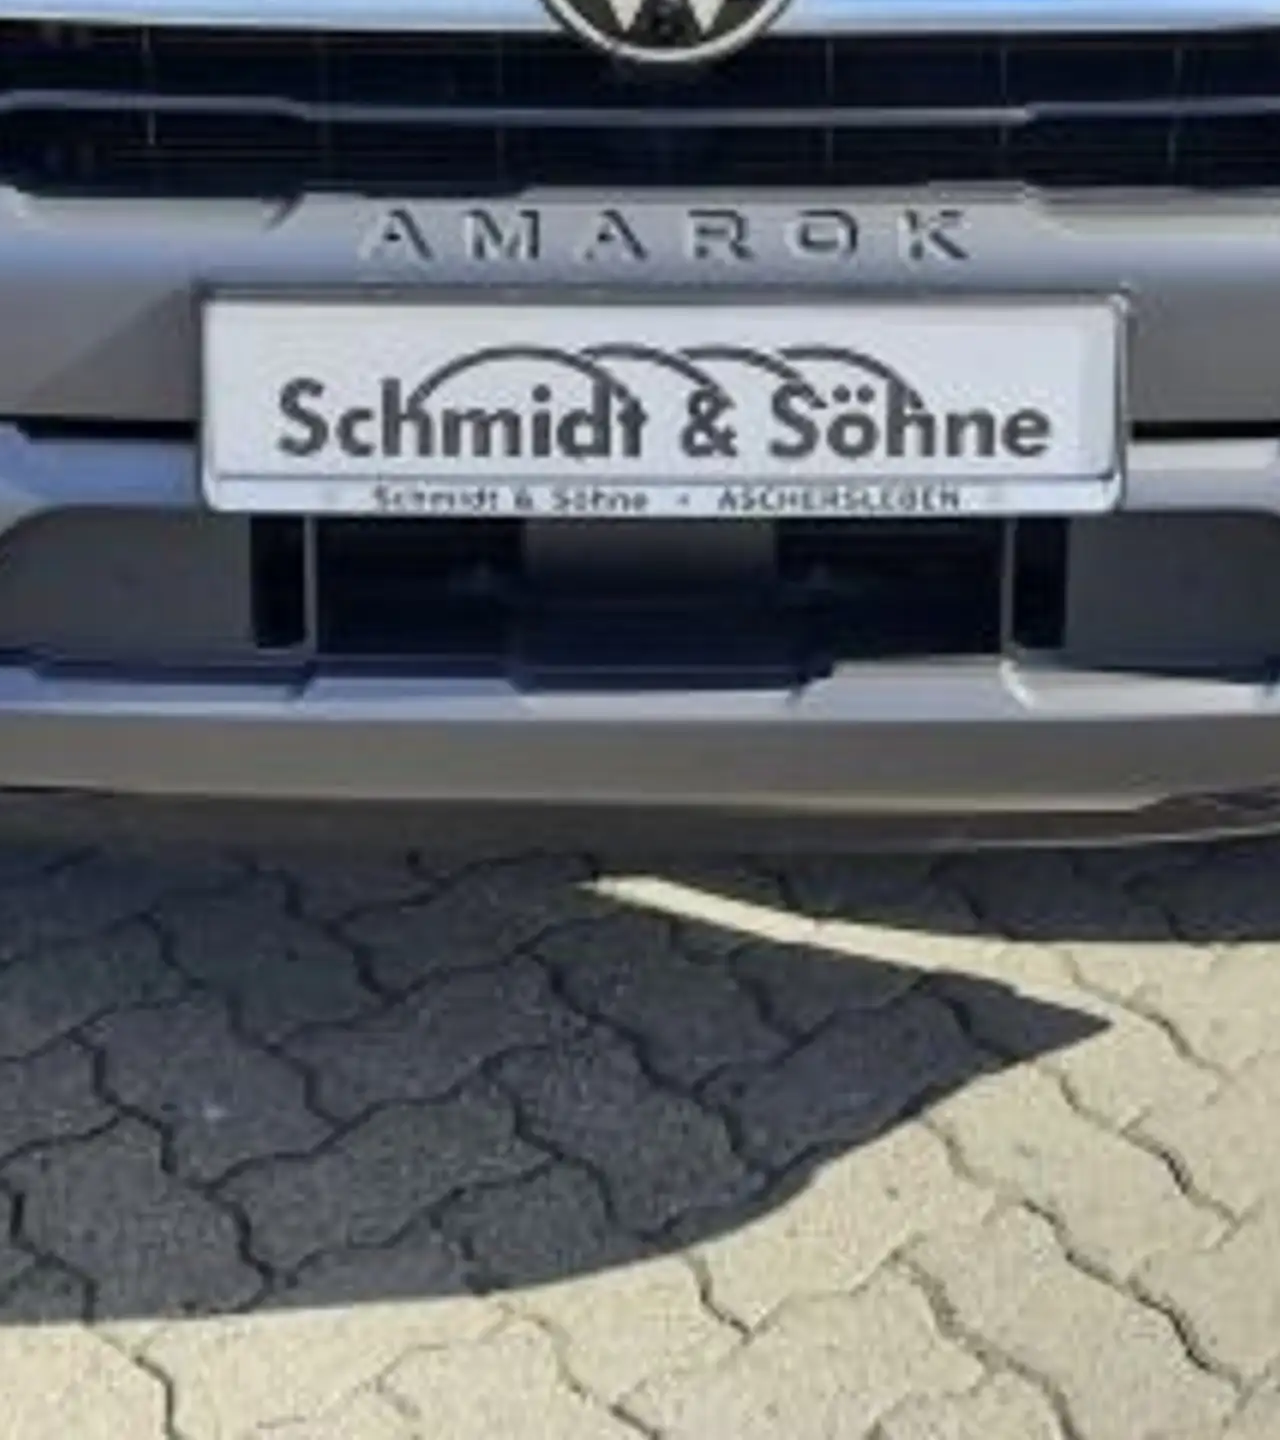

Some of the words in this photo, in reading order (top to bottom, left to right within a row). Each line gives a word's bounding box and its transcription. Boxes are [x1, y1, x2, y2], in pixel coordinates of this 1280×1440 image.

[362, 208, 972, 262] AMAROK
[277, 377, 649, 459] Schmidt
[680, 386, 738, 459] &
[769, 378, 1053, 459] Söhne
